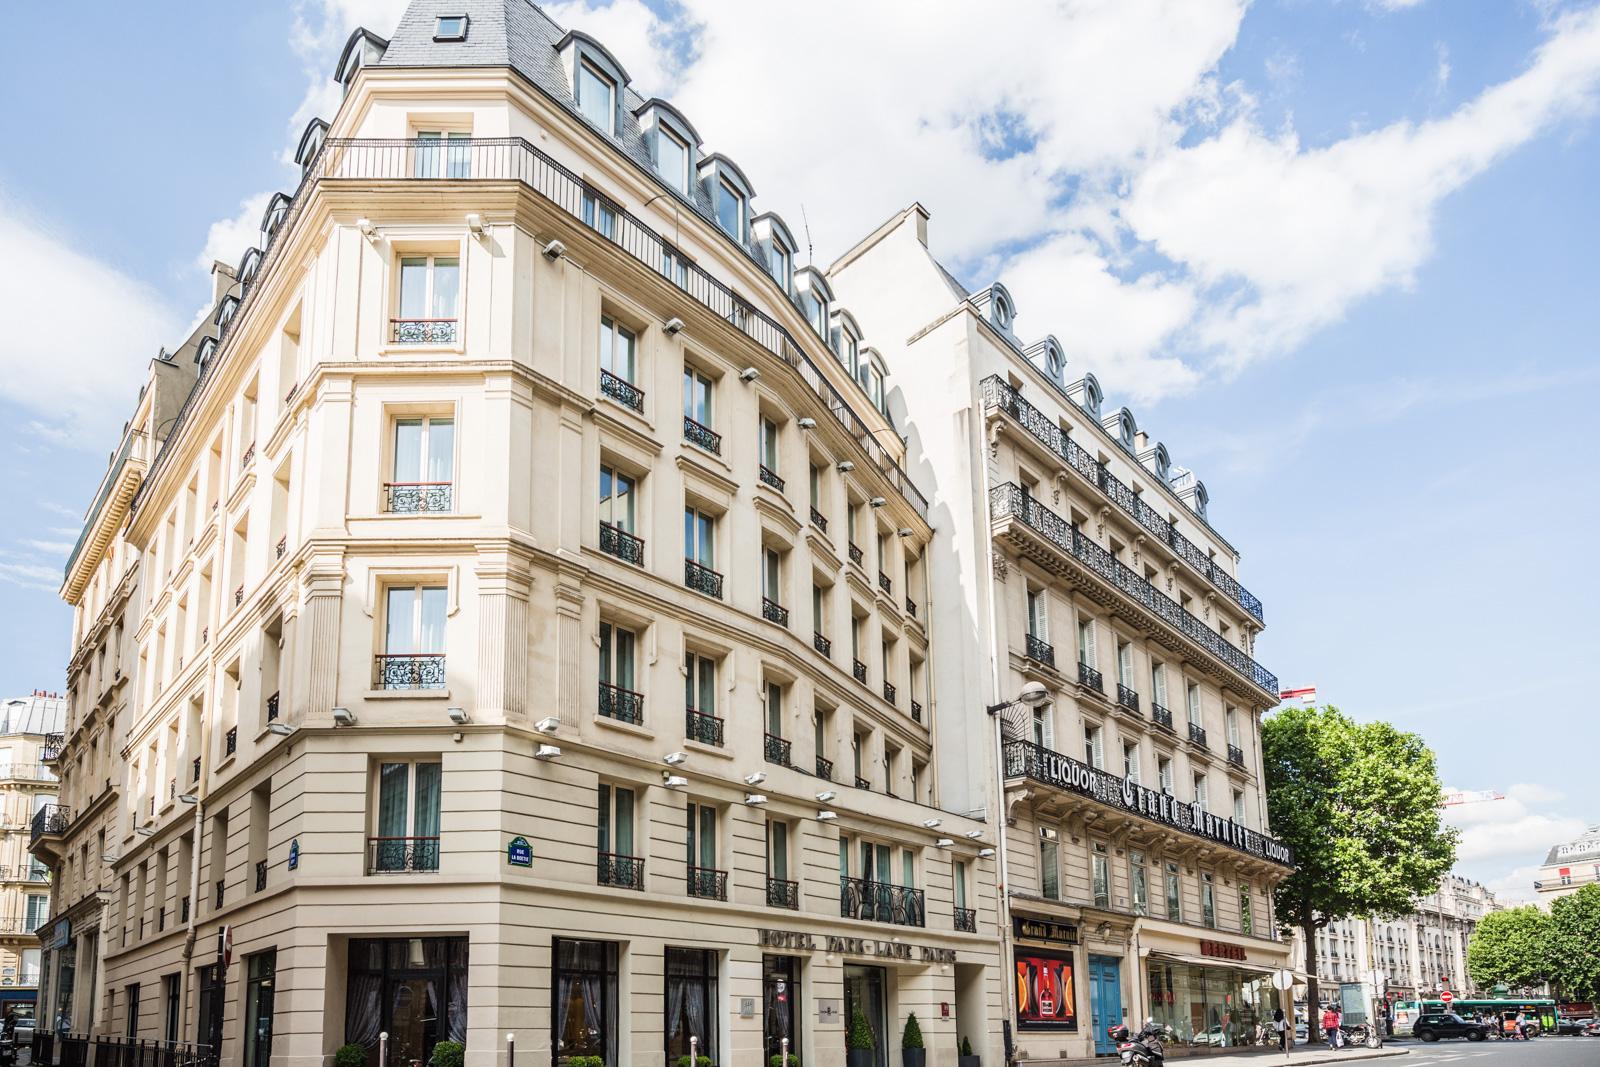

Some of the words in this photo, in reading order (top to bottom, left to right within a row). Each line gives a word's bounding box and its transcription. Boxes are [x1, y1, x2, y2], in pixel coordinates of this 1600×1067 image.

[1050, 756, 1097, 793] LIQUOR
[1122, 773, 1178, 822] Grand
[1191, 800, 1251, 851] Marnier
[1265, 840, 1290, 864] LIQUOR
[758, 929, 816, 950] HOTEL
[919, 946, 957, 963] PARIS
[1200, 940, 1247, 960] BERTEIL
